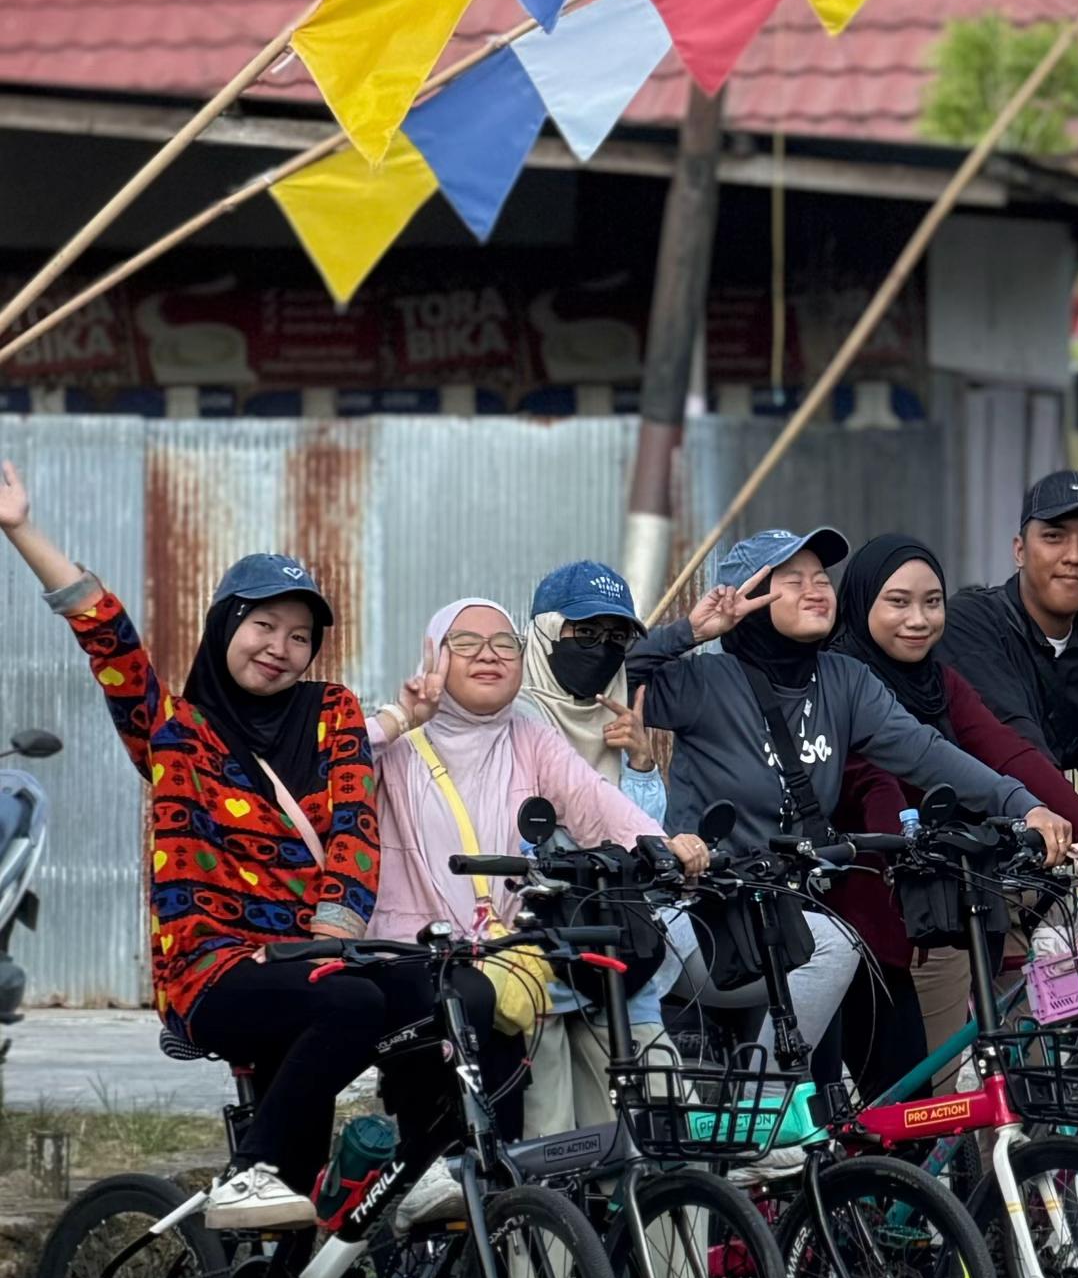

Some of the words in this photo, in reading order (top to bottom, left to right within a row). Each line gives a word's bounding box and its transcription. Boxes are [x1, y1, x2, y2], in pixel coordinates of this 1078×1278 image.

[394, 288, 508, 329] TORA
[908, 1110, 928, 1123] PRO
[930, 1103, 965, 1119] ACTION
[547, 1146, 564, 1157] PRO
[567, 1139, 597, 1153] ACTION
[350, 1161, 405, 1223] THRILL
